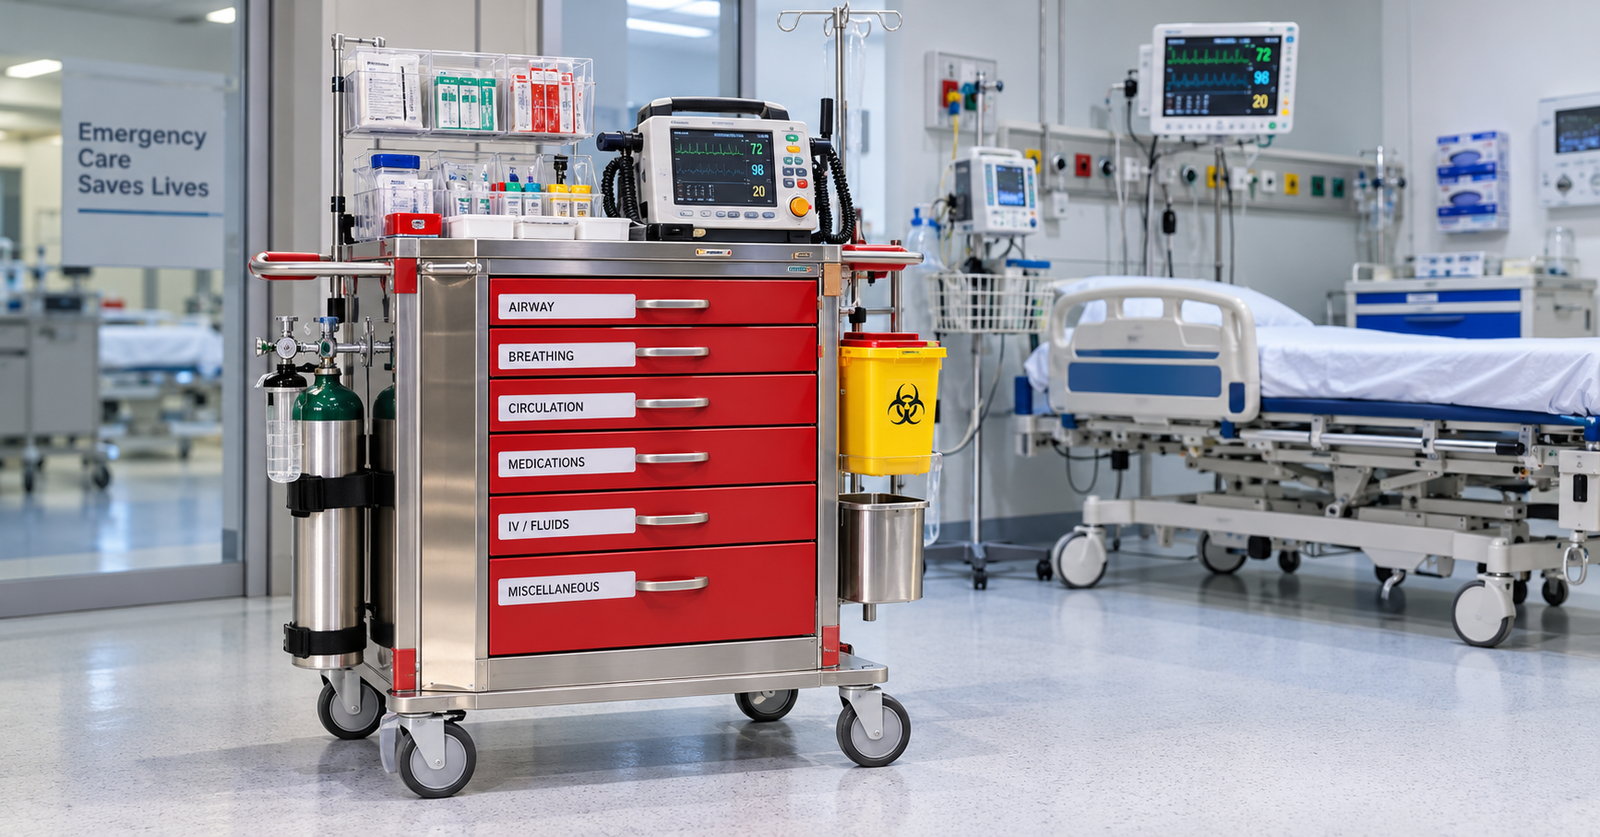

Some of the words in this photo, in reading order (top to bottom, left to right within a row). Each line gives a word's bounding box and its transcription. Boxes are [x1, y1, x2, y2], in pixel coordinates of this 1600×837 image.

[1256, 47, 1272, 62] 72
[1254, 70, 1270, 85] 98
[1252, 94, 1269, 109] 20
[78, 121, 207, 151] Emergency
[750, 143, 763, 155] 72
[78, 148, 131, 169] Care
[751, 164, 764, 176] 98
[78, 174, 144, 196] Saves
[152, 176, 209, 198] Lives
[752, 185, 765, 197] 20
[508, 301, 555, 313] AIRWAY
[508, 350, 574, 363] BREATHING
[508, 401, 584, 414] CIRCULATION
[508, 456, 585, 470] MEDICATIONS
[508, 520, 519, 532] IV
[522, 520, 528, 532] /
[530, 518, 570, 531] FLUIDS
[508, 581, 600, 598] MISCELLANEOUS
